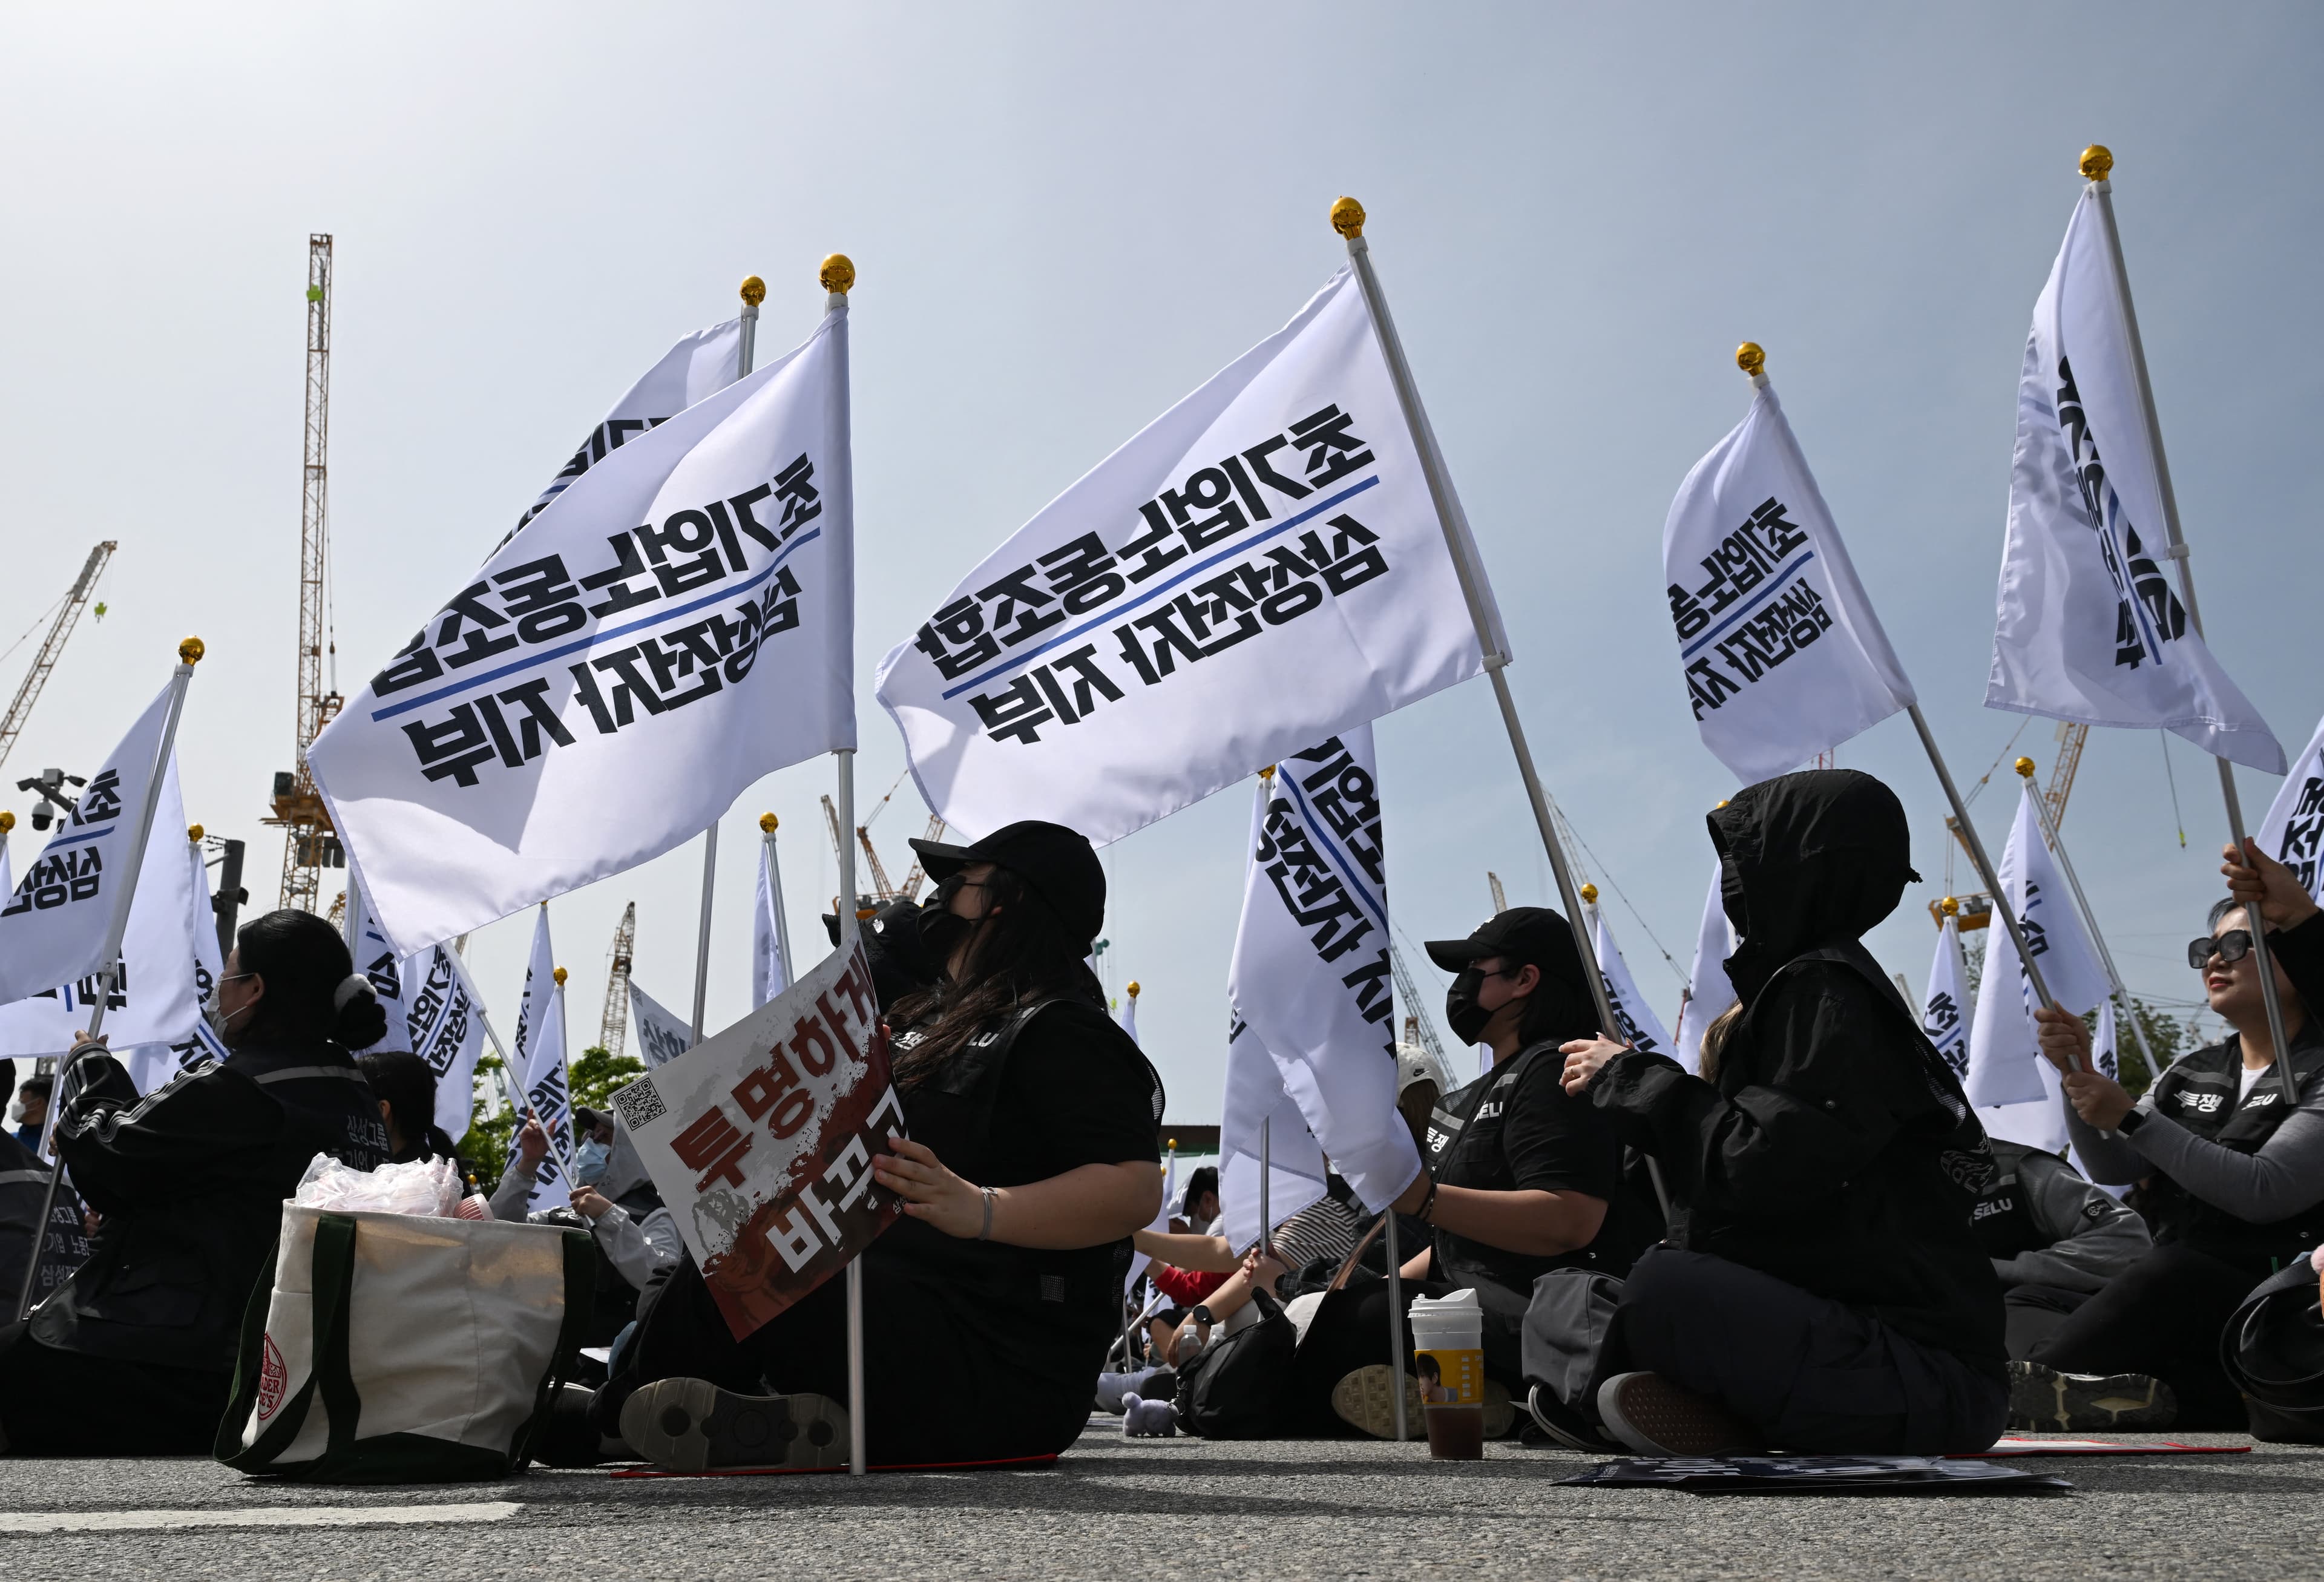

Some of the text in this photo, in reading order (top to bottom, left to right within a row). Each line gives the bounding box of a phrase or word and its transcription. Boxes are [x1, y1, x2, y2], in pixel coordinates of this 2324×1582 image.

[670, 943, 878, 1193] 투명하게
[2173, 1089, 2224, 1112] 투쟁
[1974, 1198, 2013, 1220] SELU
